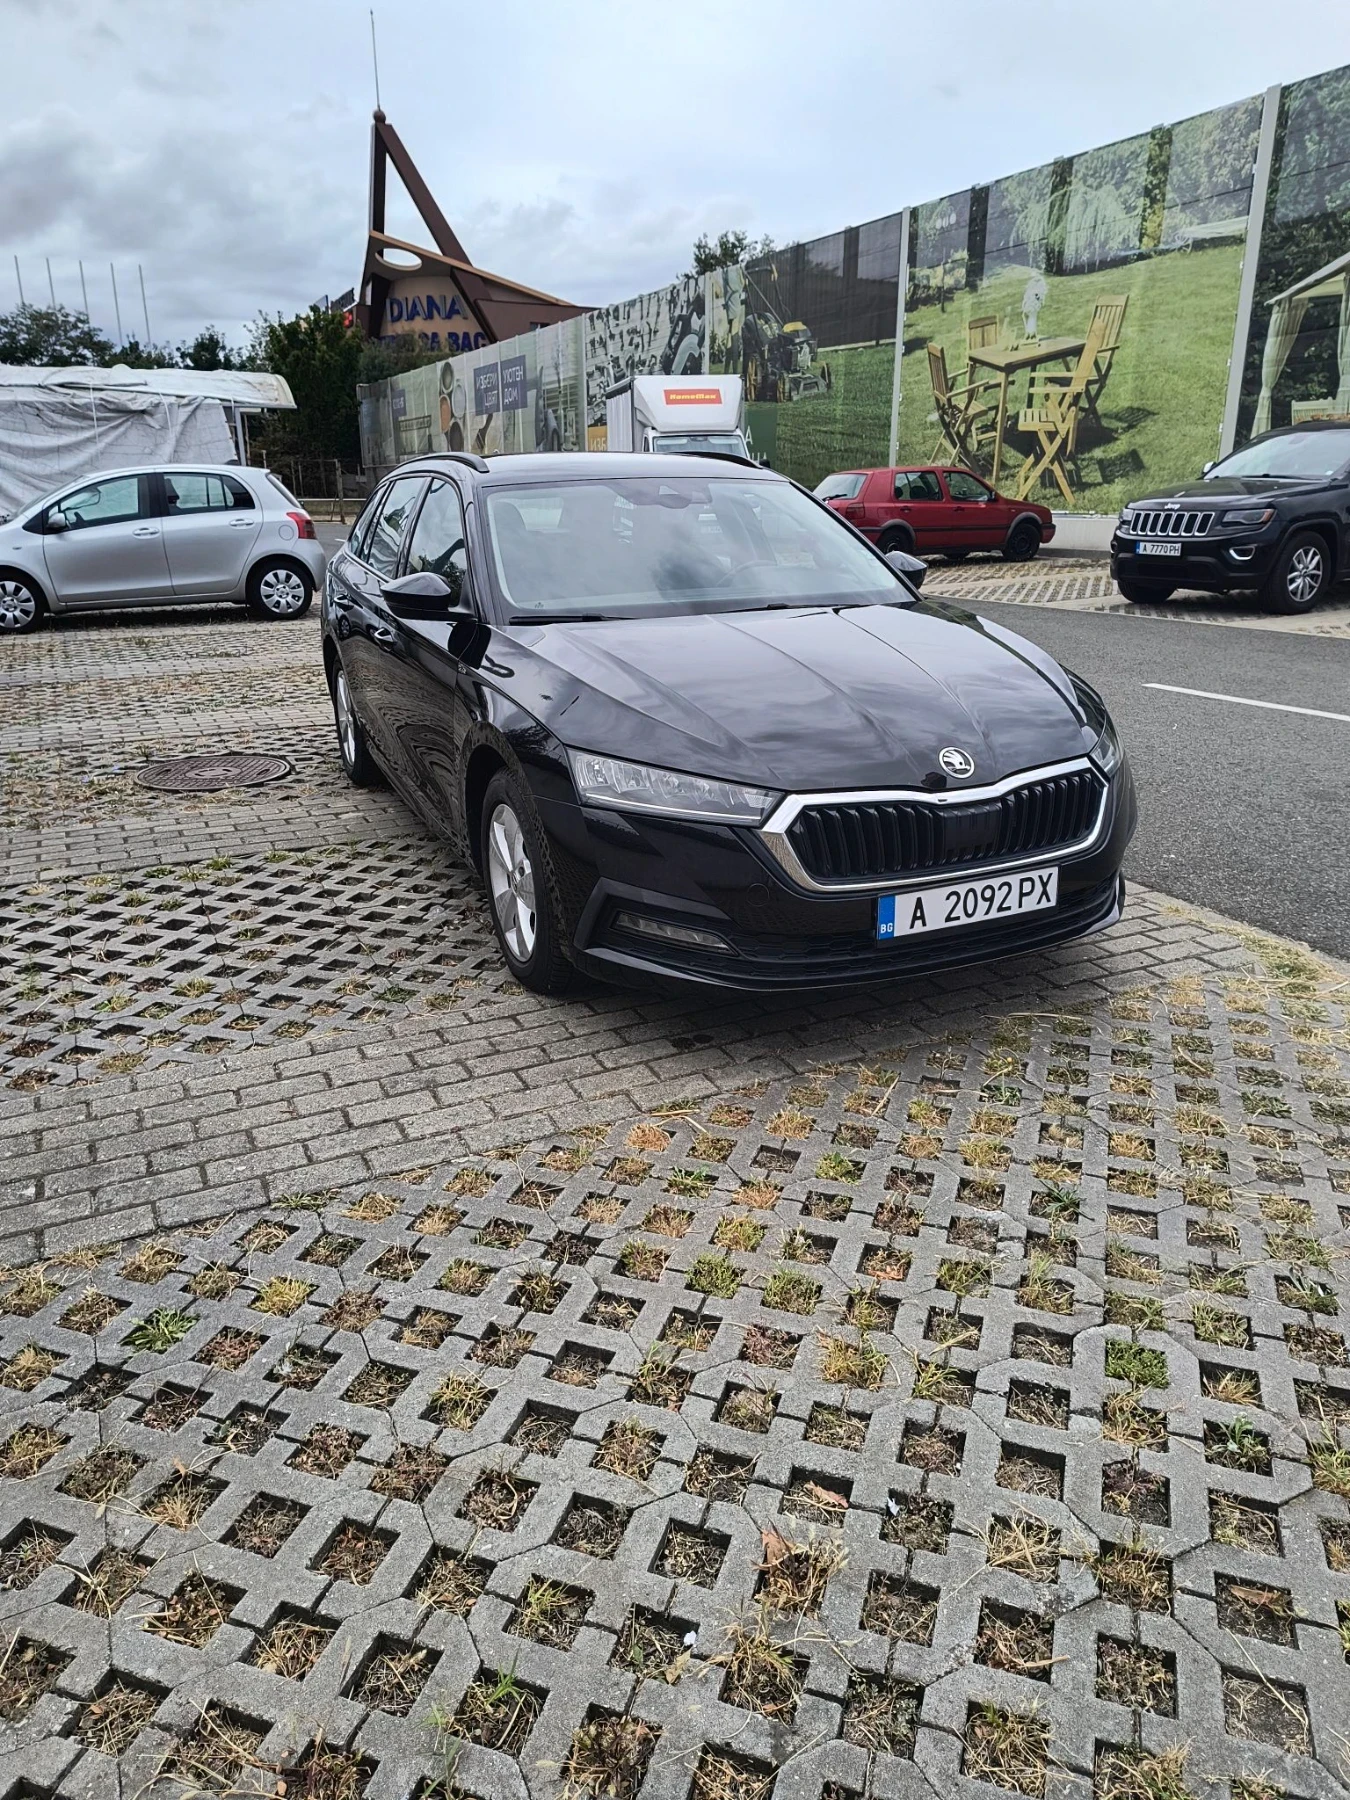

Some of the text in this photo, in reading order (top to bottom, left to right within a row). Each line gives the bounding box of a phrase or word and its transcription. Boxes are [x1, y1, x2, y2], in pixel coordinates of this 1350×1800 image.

[387, 294, 468, 323] DIANA
[476, 372, 498, 389] ИЗБЕРИ
[503, 387, 519, 405] ДОМ
[1142, 544, 1148, 553] A
[909, 896, 927, 930] A
[880, 922, 893, 935] BG
